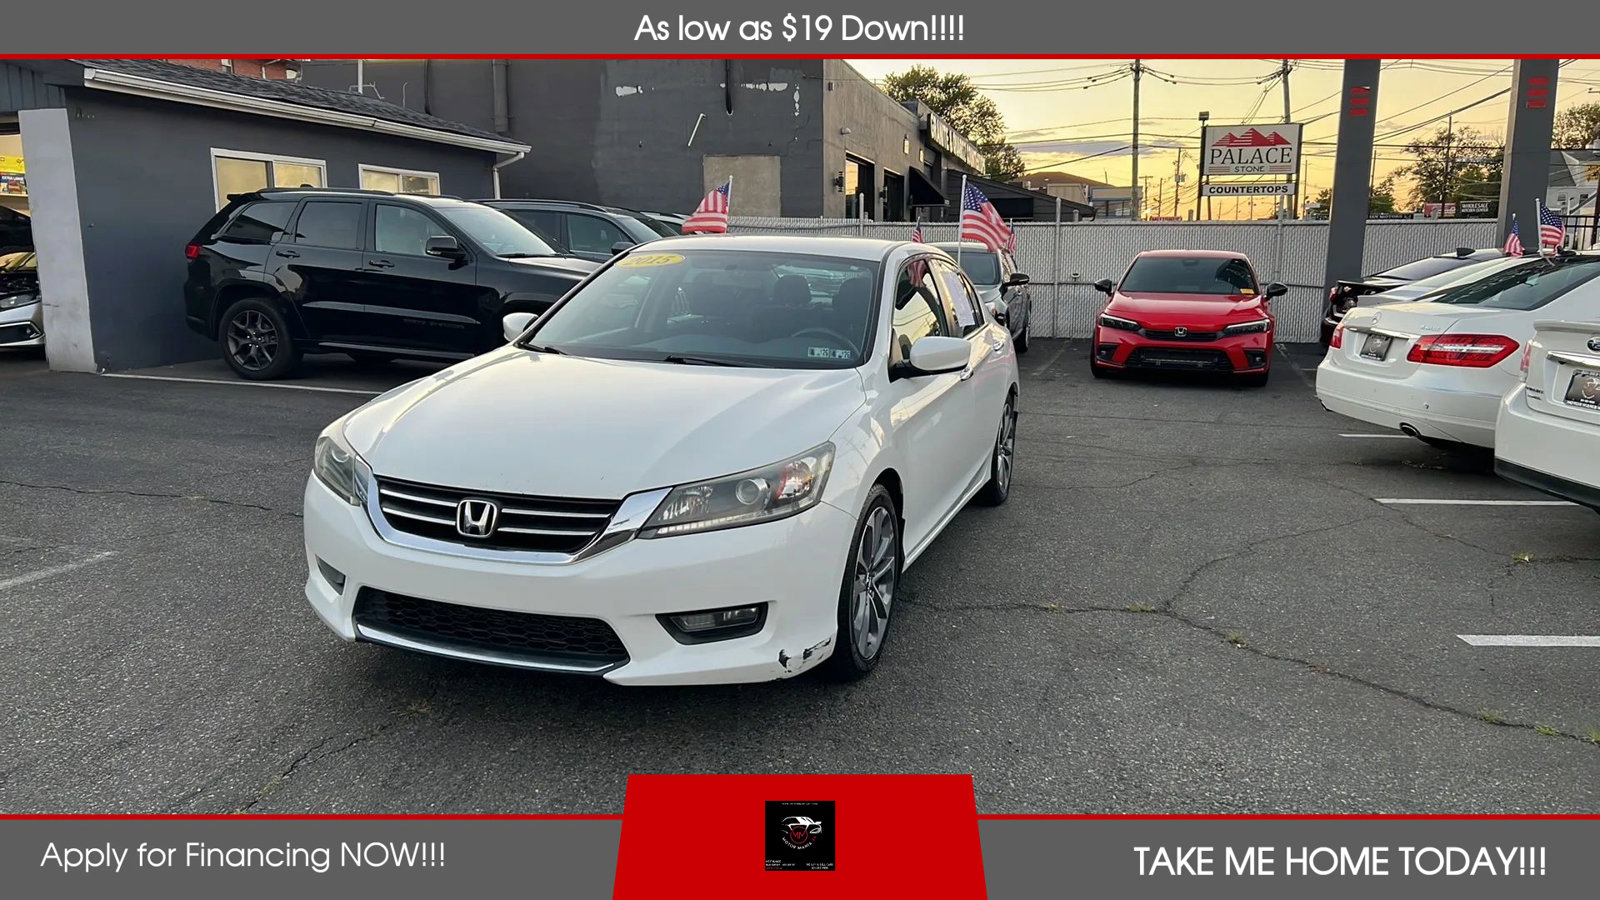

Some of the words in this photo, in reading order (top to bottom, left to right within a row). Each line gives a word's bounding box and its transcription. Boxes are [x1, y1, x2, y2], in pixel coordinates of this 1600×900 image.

[1209, 147, 1292, 165] PALACE
[1234, 165, 1265, 173] STONE
[1208, 185, 1289, 194] COUNTERTOPS
